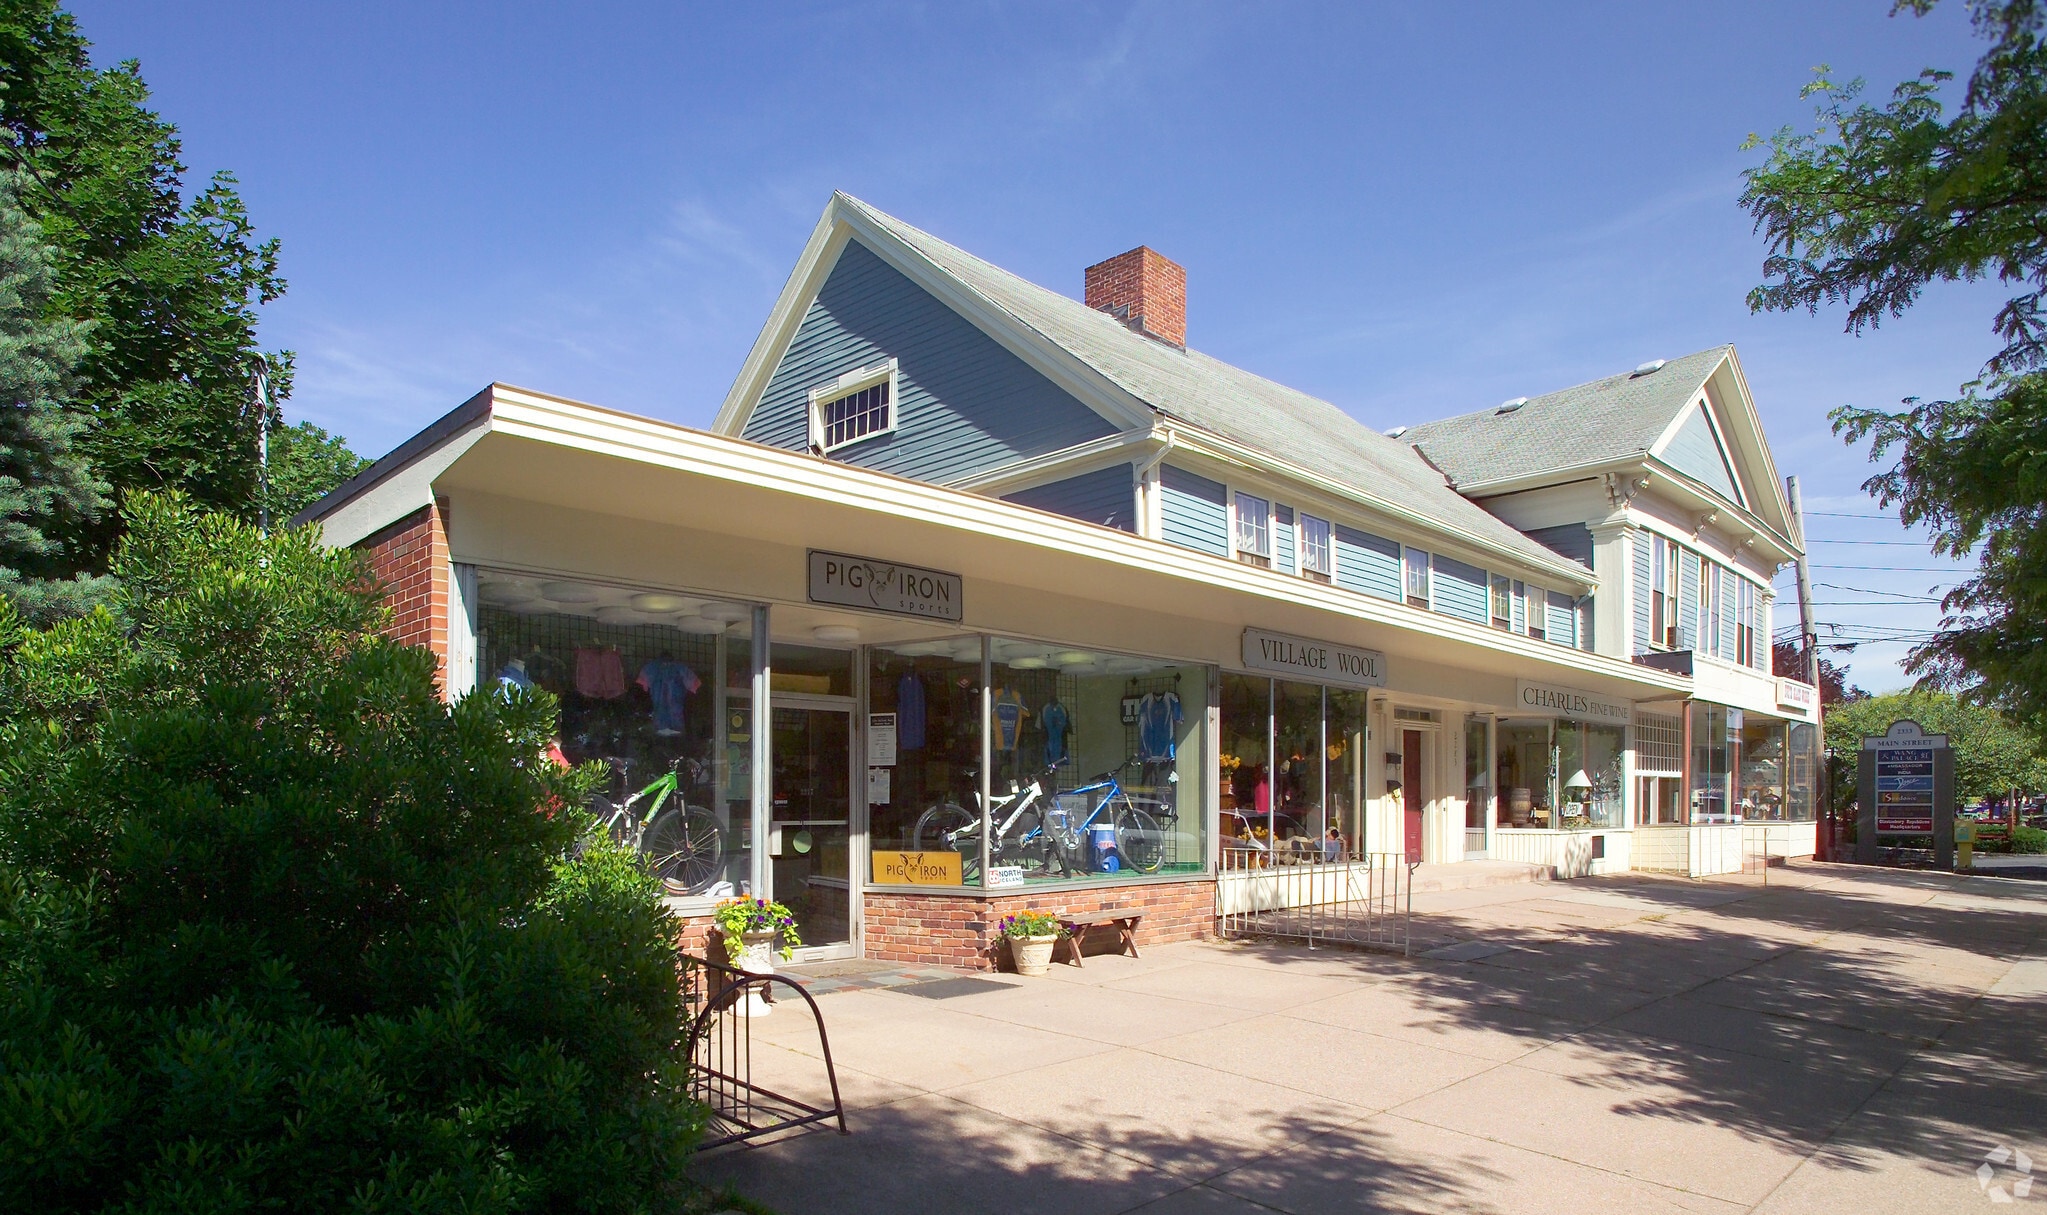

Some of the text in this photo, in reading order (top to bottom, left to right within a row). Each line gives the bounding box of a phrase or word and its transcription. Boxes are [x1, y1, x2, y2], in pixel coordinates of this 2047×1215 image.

[826, 561, 950, 602] PIG IRON
[899, 600, 950, 615] sports
[1260, 638, 1378, 678] VILLAGE WOOL
[1523, 687, 1628, 719] CHARLES FINE WINE
[886, 865, 947, 877] PIG IRON
[998, 869, 1022, 877] NORTH
